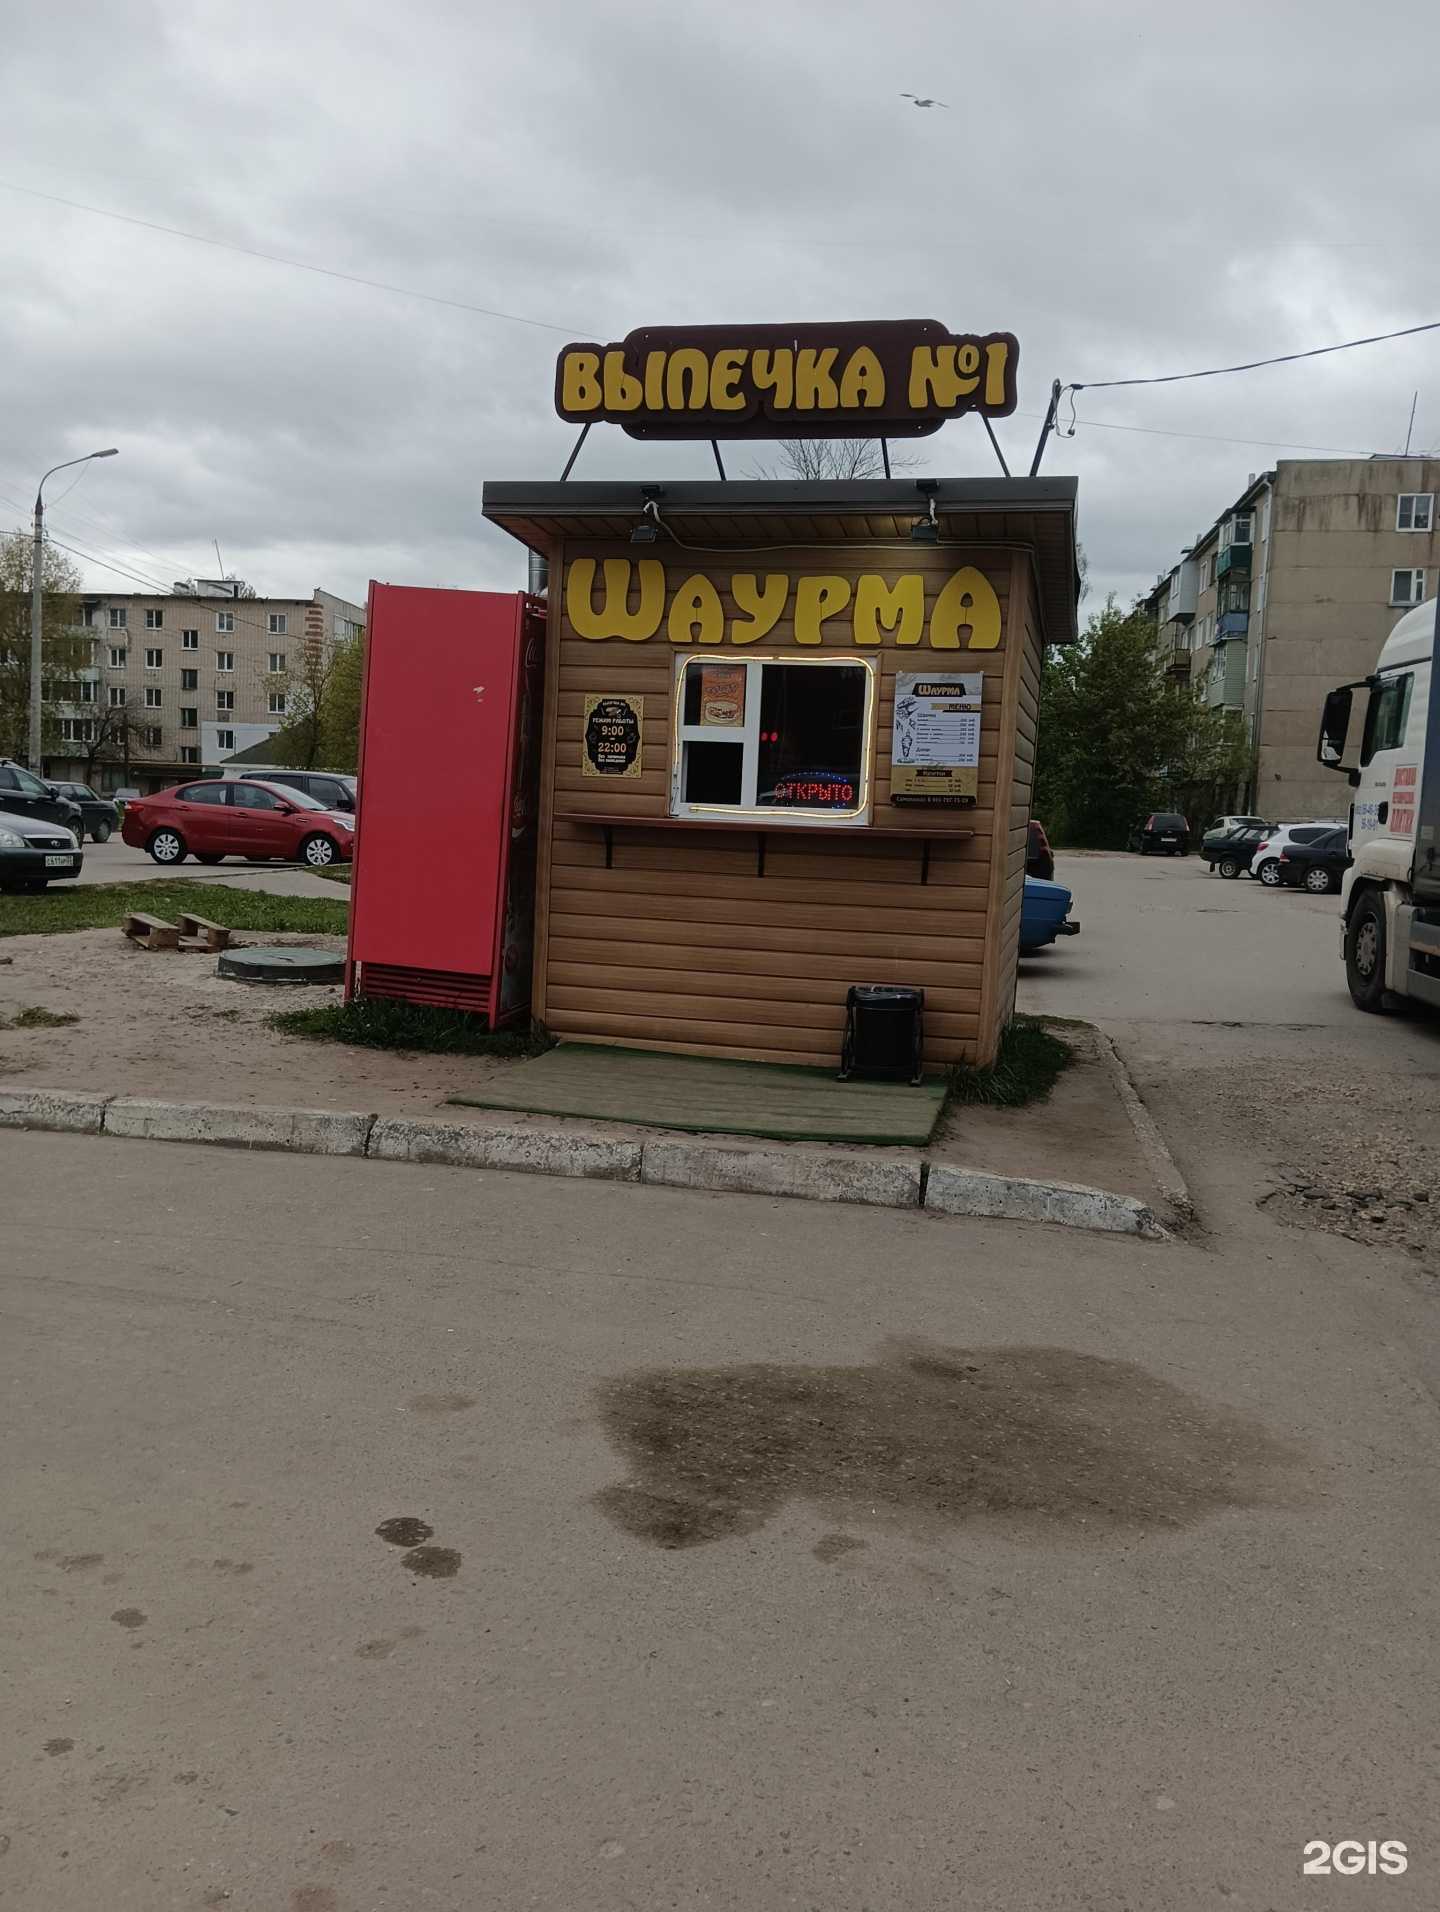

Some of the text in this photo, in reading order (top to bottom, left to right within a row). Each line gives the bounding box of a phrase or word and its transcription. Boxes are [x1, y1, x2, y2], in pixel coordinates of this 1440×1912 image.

[562, 345, 886, 411] ВЫПЕЧКА
[566, 558, 1002, 649] ШАУРМА
[602, 726, 624, 735] 9:00
[598, 743, 627, 753] 22:00
[775, 783, 853, 801] ОТКРЫТО
